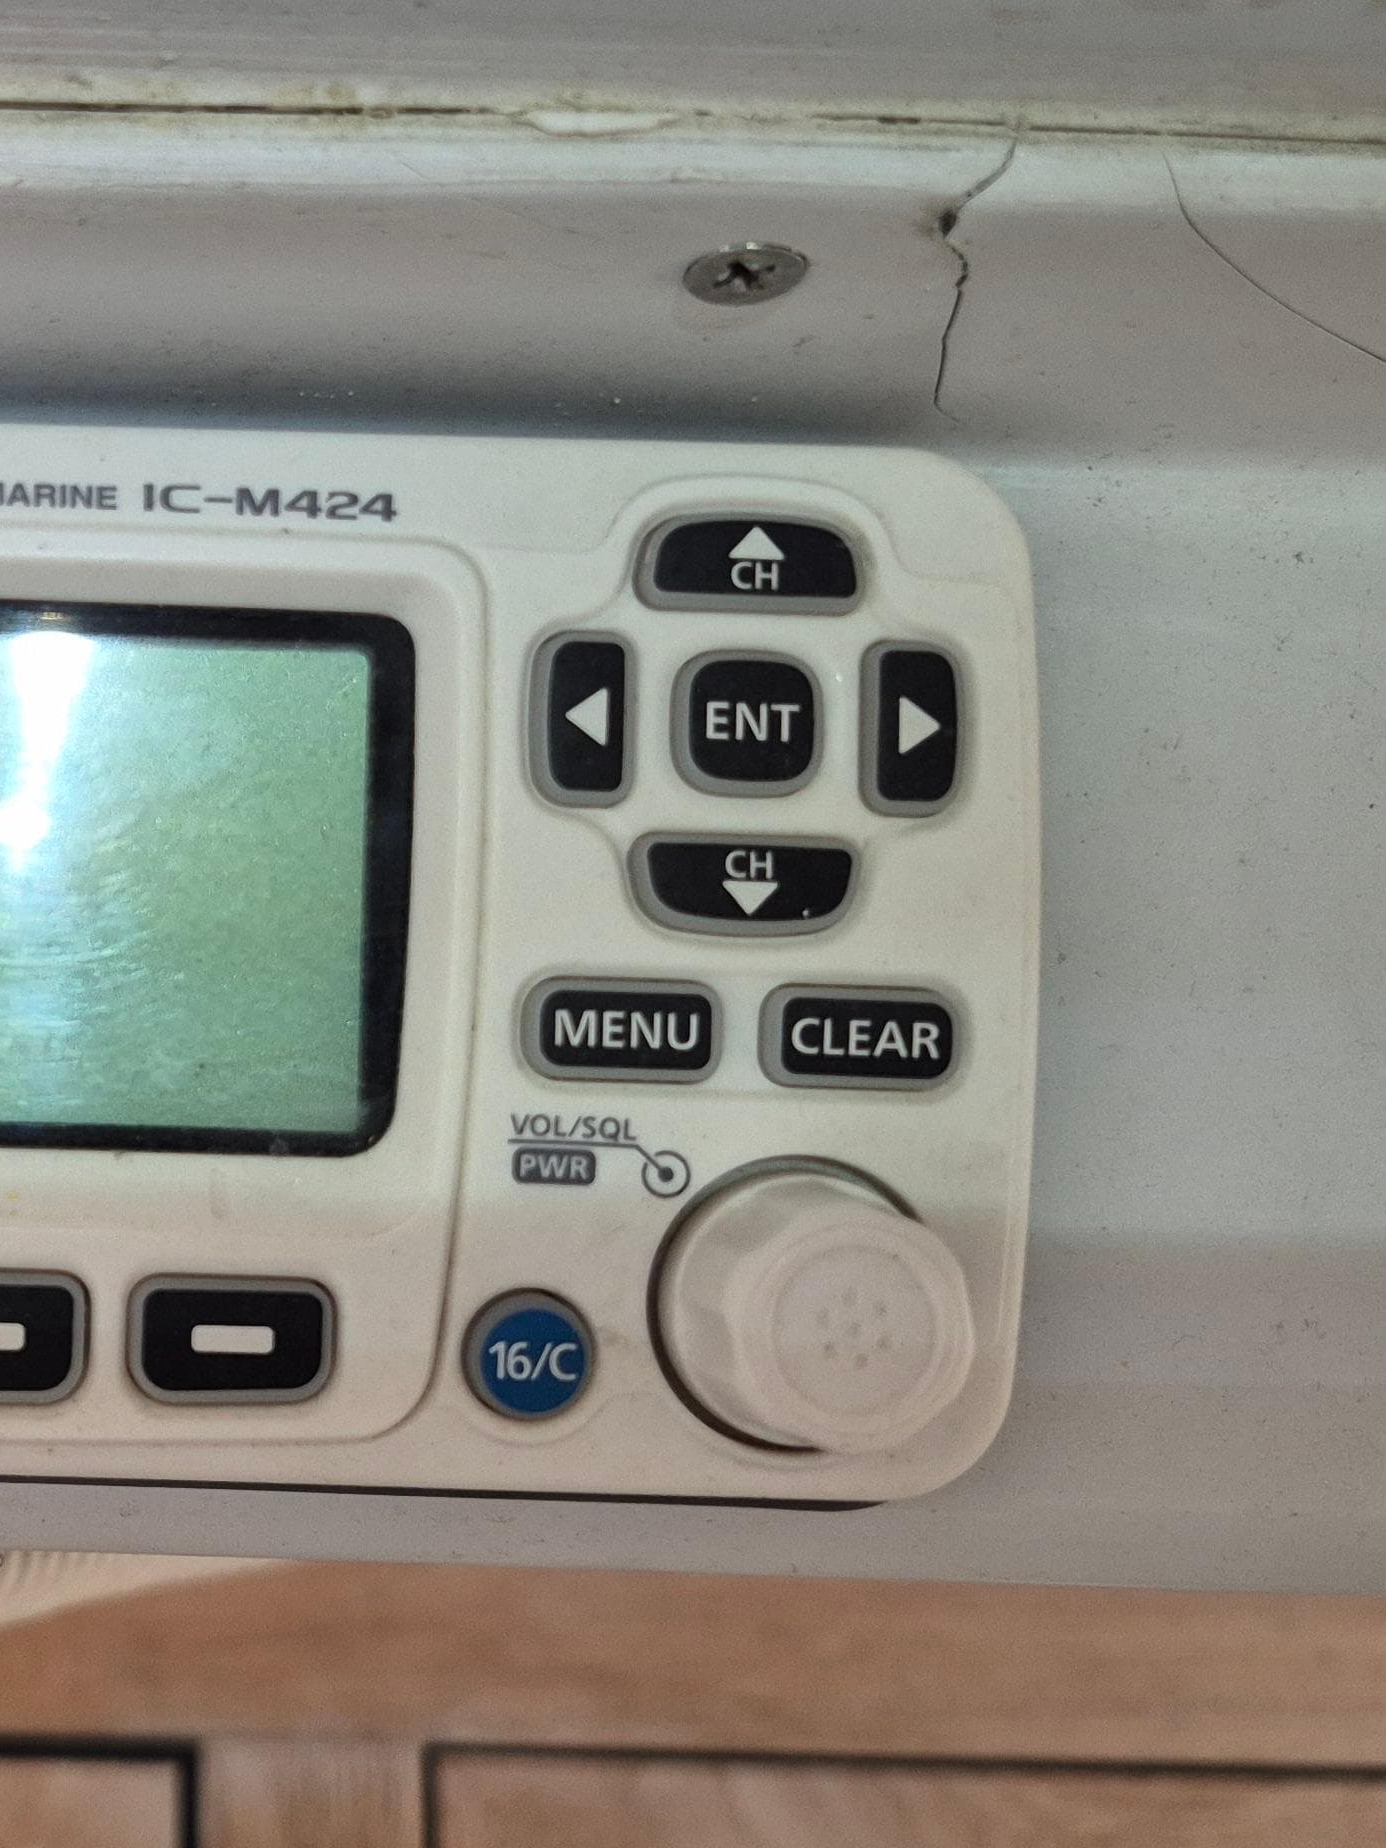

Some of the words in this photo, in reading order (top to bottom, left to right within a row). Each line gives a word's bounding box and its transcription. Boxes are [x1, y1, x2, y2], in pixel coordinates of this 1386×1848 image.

[141, 483, 399, 523] IC-M424
[730, 560, 779, 590] CH
[705, 701, 801, 743] ENT
[724, 850, 775, 880] CH
[553, 1008, 700, 1051] MENU
[790, 1017, 941, 1060] CLEAR
[510, 1113, 638, 1142] VOL/SQL
[518, 1152, 590, 1178] PWR
[488, 1341, 578, 1382] 16/C
